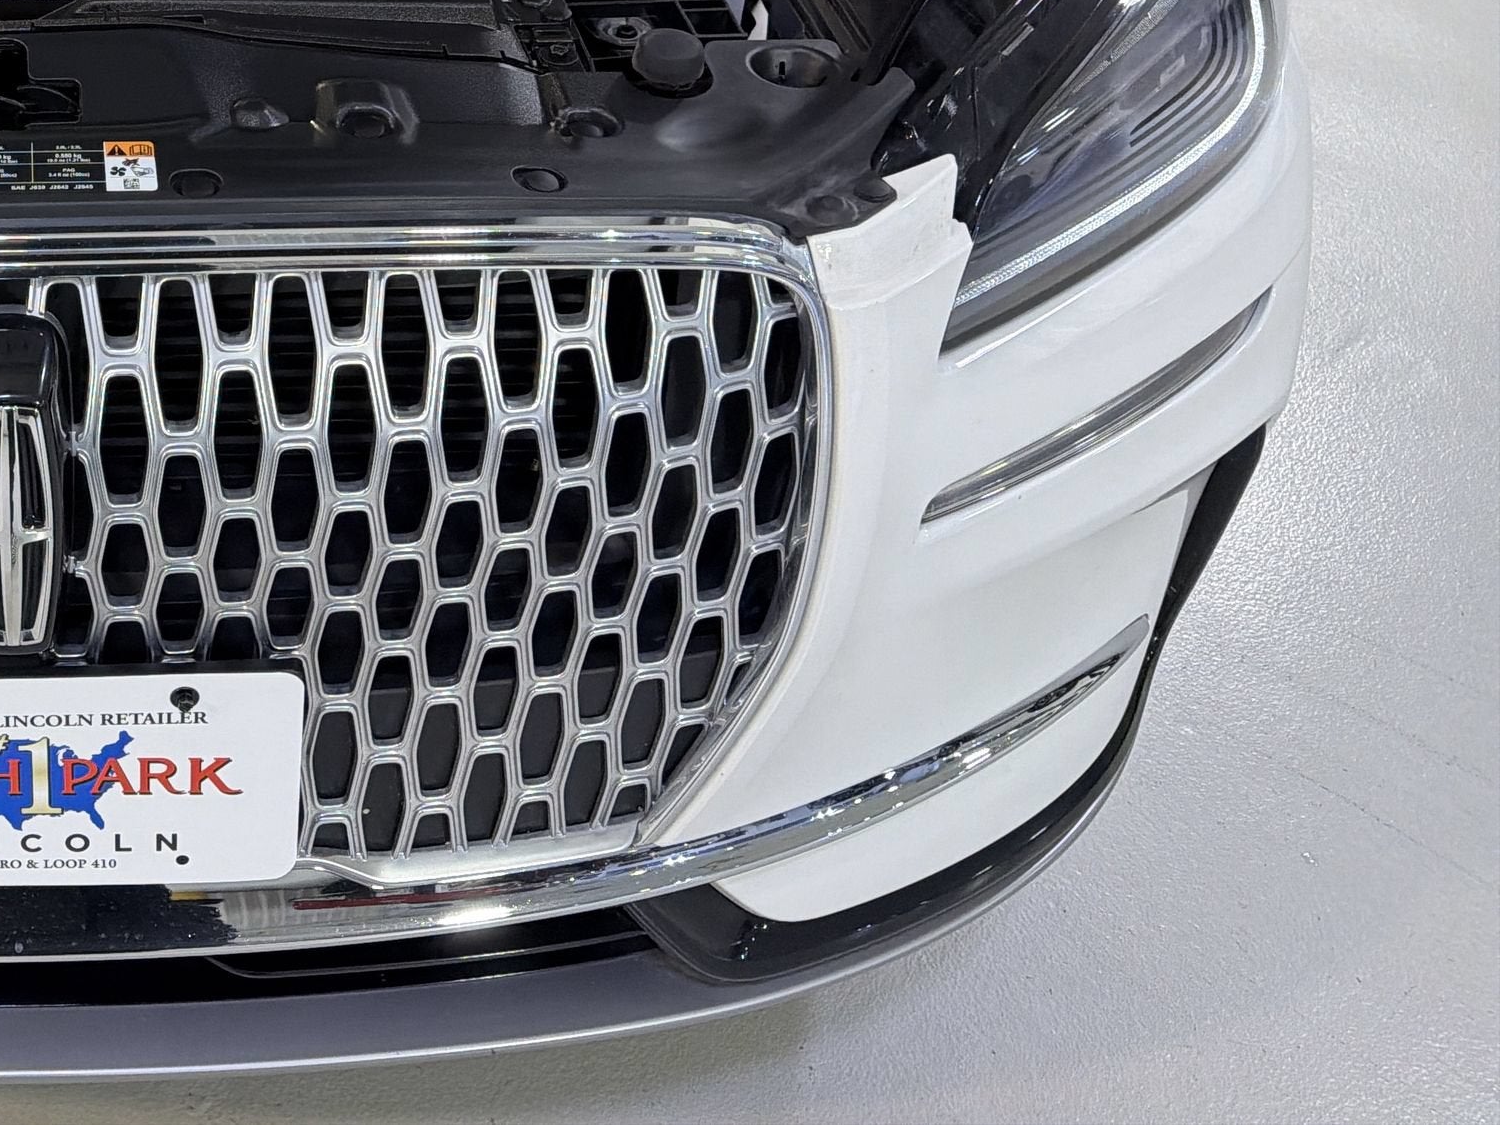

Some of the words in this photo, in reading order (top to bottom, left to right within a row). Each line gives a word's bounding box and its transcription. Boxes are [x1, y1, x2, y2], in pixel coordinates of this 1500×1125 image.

[100, 711, 208, 726] RETAILER
[61, 757, 244, 796] PARK
[26, 858, 39, 869] &
[43, 858, 87, 870] LOOP
[91, 858, 117, 869] 410
